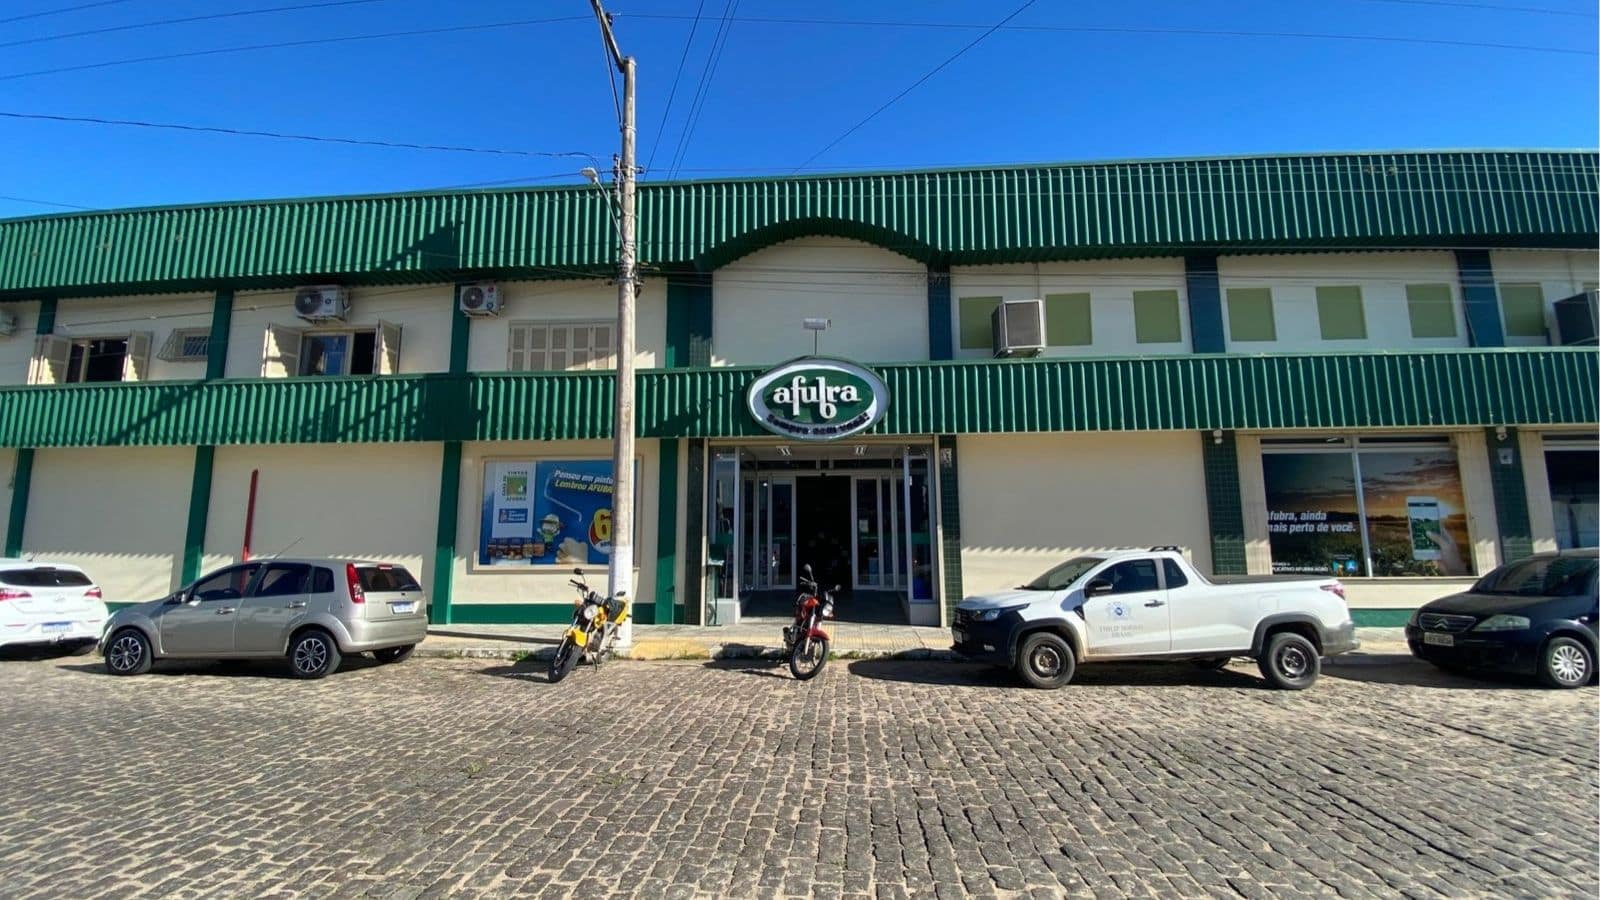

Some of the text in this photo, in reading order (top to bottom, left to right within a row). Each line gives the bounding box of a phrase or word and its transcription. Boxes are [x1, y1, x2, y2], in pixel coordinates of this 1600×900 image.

[773, 375, 862, 419] afubra
[554, 469, 581, 480] Pensou
[554, 479, 588, 490] Lembrou
[1300, 510, 1327, 521] ainda
[1289, 522, 1315, 535] perto
[1316, 521, 1329, 533] de
[1331, 520, 1357, 533] você.
